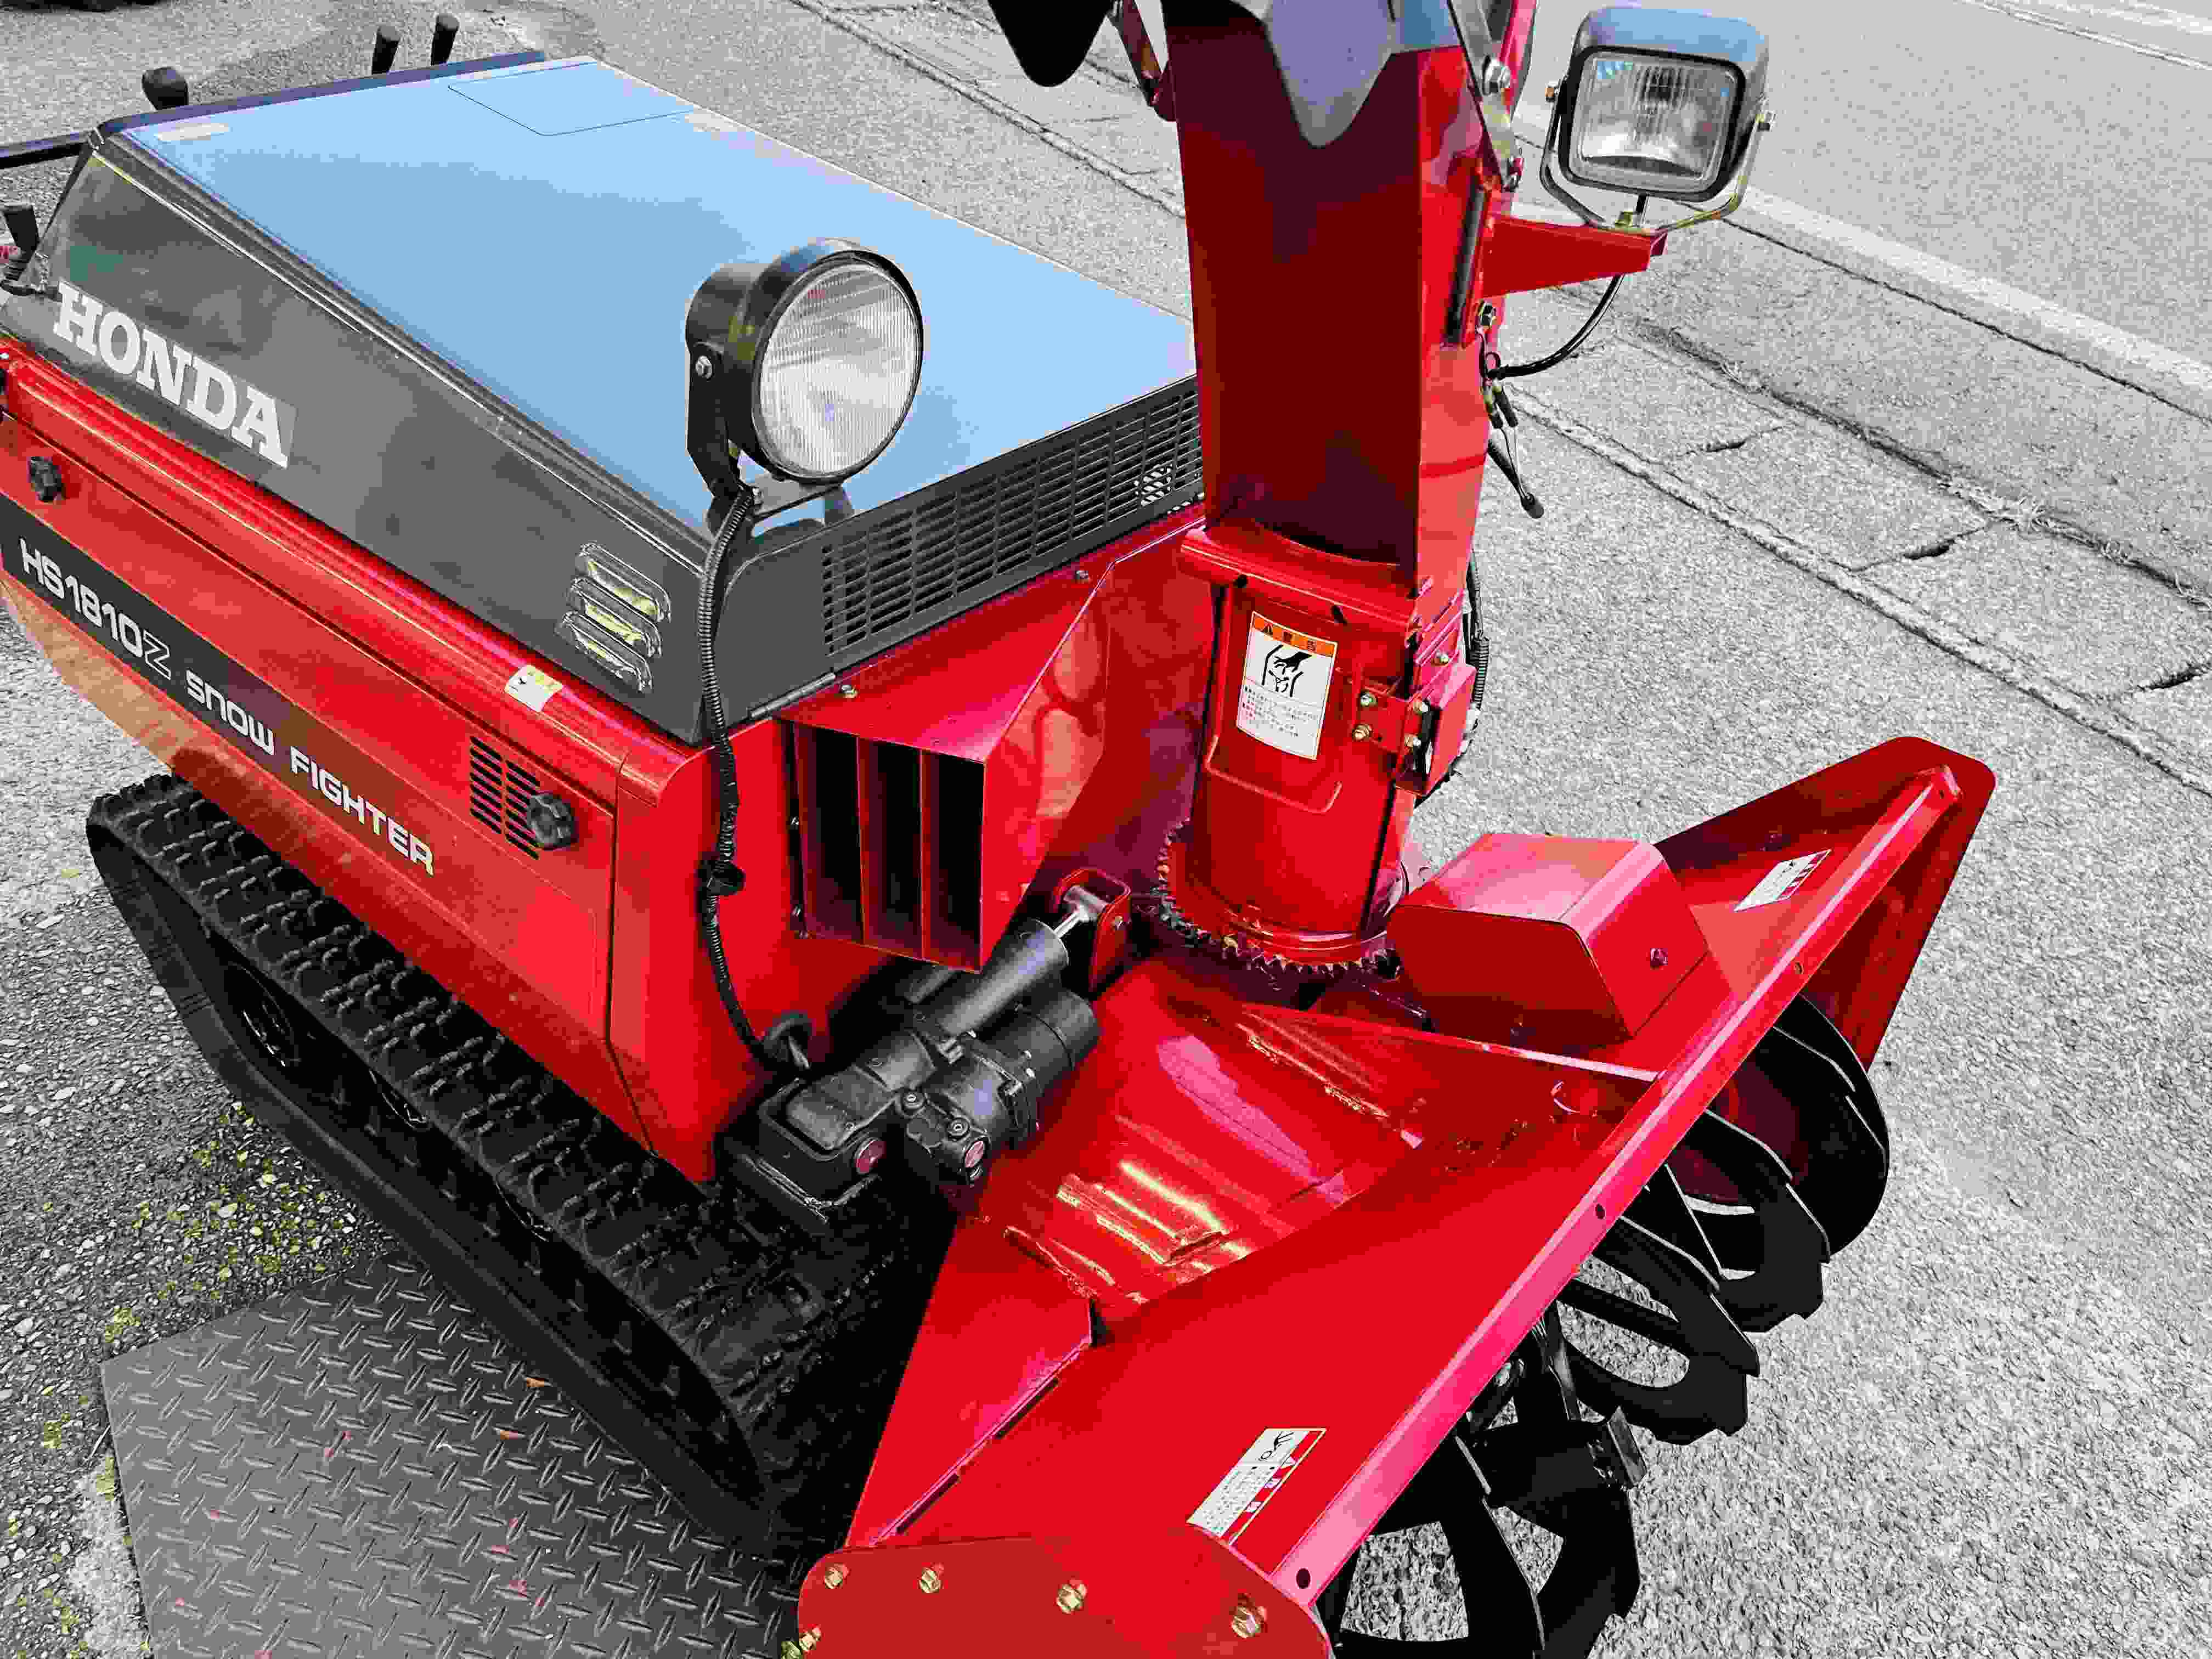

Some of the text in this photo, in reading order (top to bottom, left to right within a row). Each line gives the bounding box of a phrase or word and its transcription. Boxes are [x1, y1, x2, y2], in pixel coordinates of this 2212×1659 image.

[53, 281, 289, 468] HONDA
[19, 537, 171, 680] HS1810Z
[290, 746, 434, 876] FIGHTER
